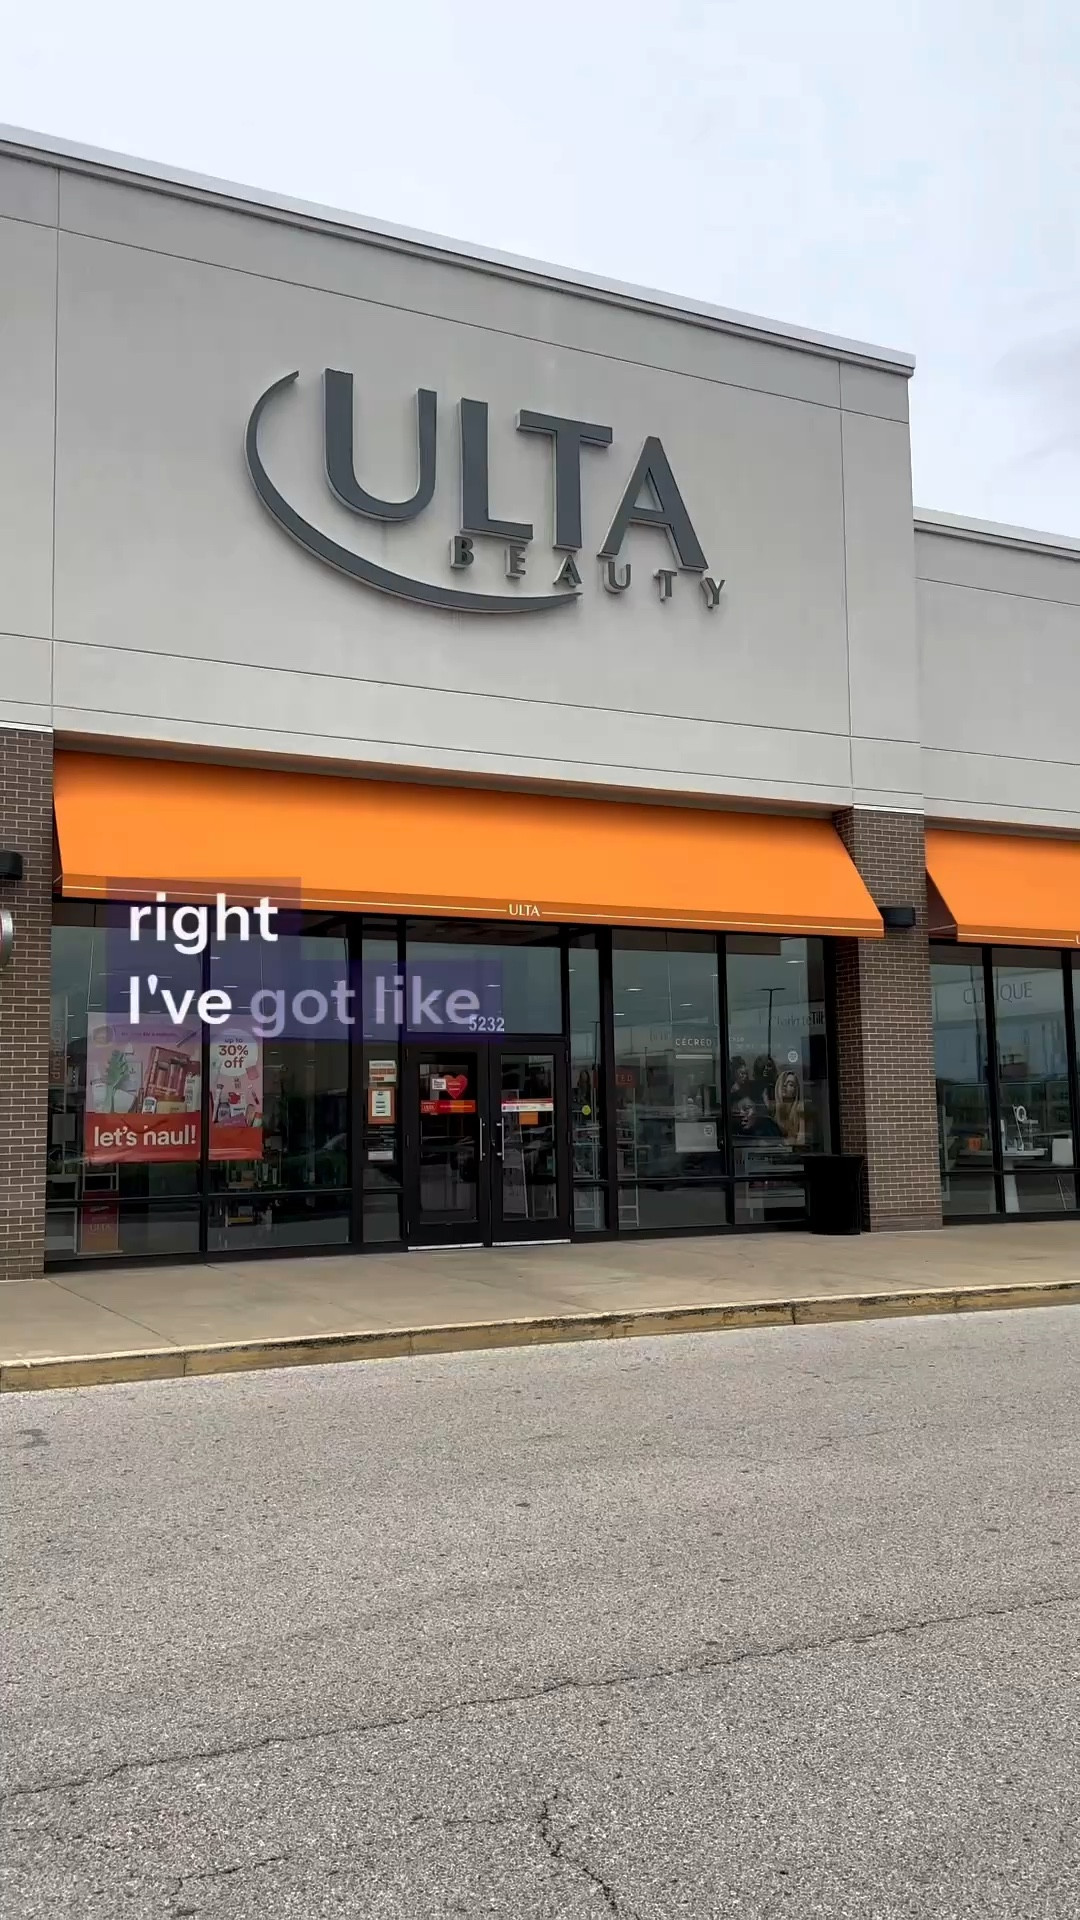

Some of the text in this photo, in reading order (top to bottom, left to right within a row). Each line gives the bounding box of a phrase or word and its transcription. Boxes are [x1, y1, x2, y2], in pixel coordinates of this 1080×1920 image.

[323, 368, 709, 572] ULTA
[450, 535, 726, 608] BEAUTY
[508, 903, 541, 917] ULTA
[469, 1017, 504, 1032] 5232
[218, 1045, 249, 1056] 30%
[224, 1057, 244, 1069] off
